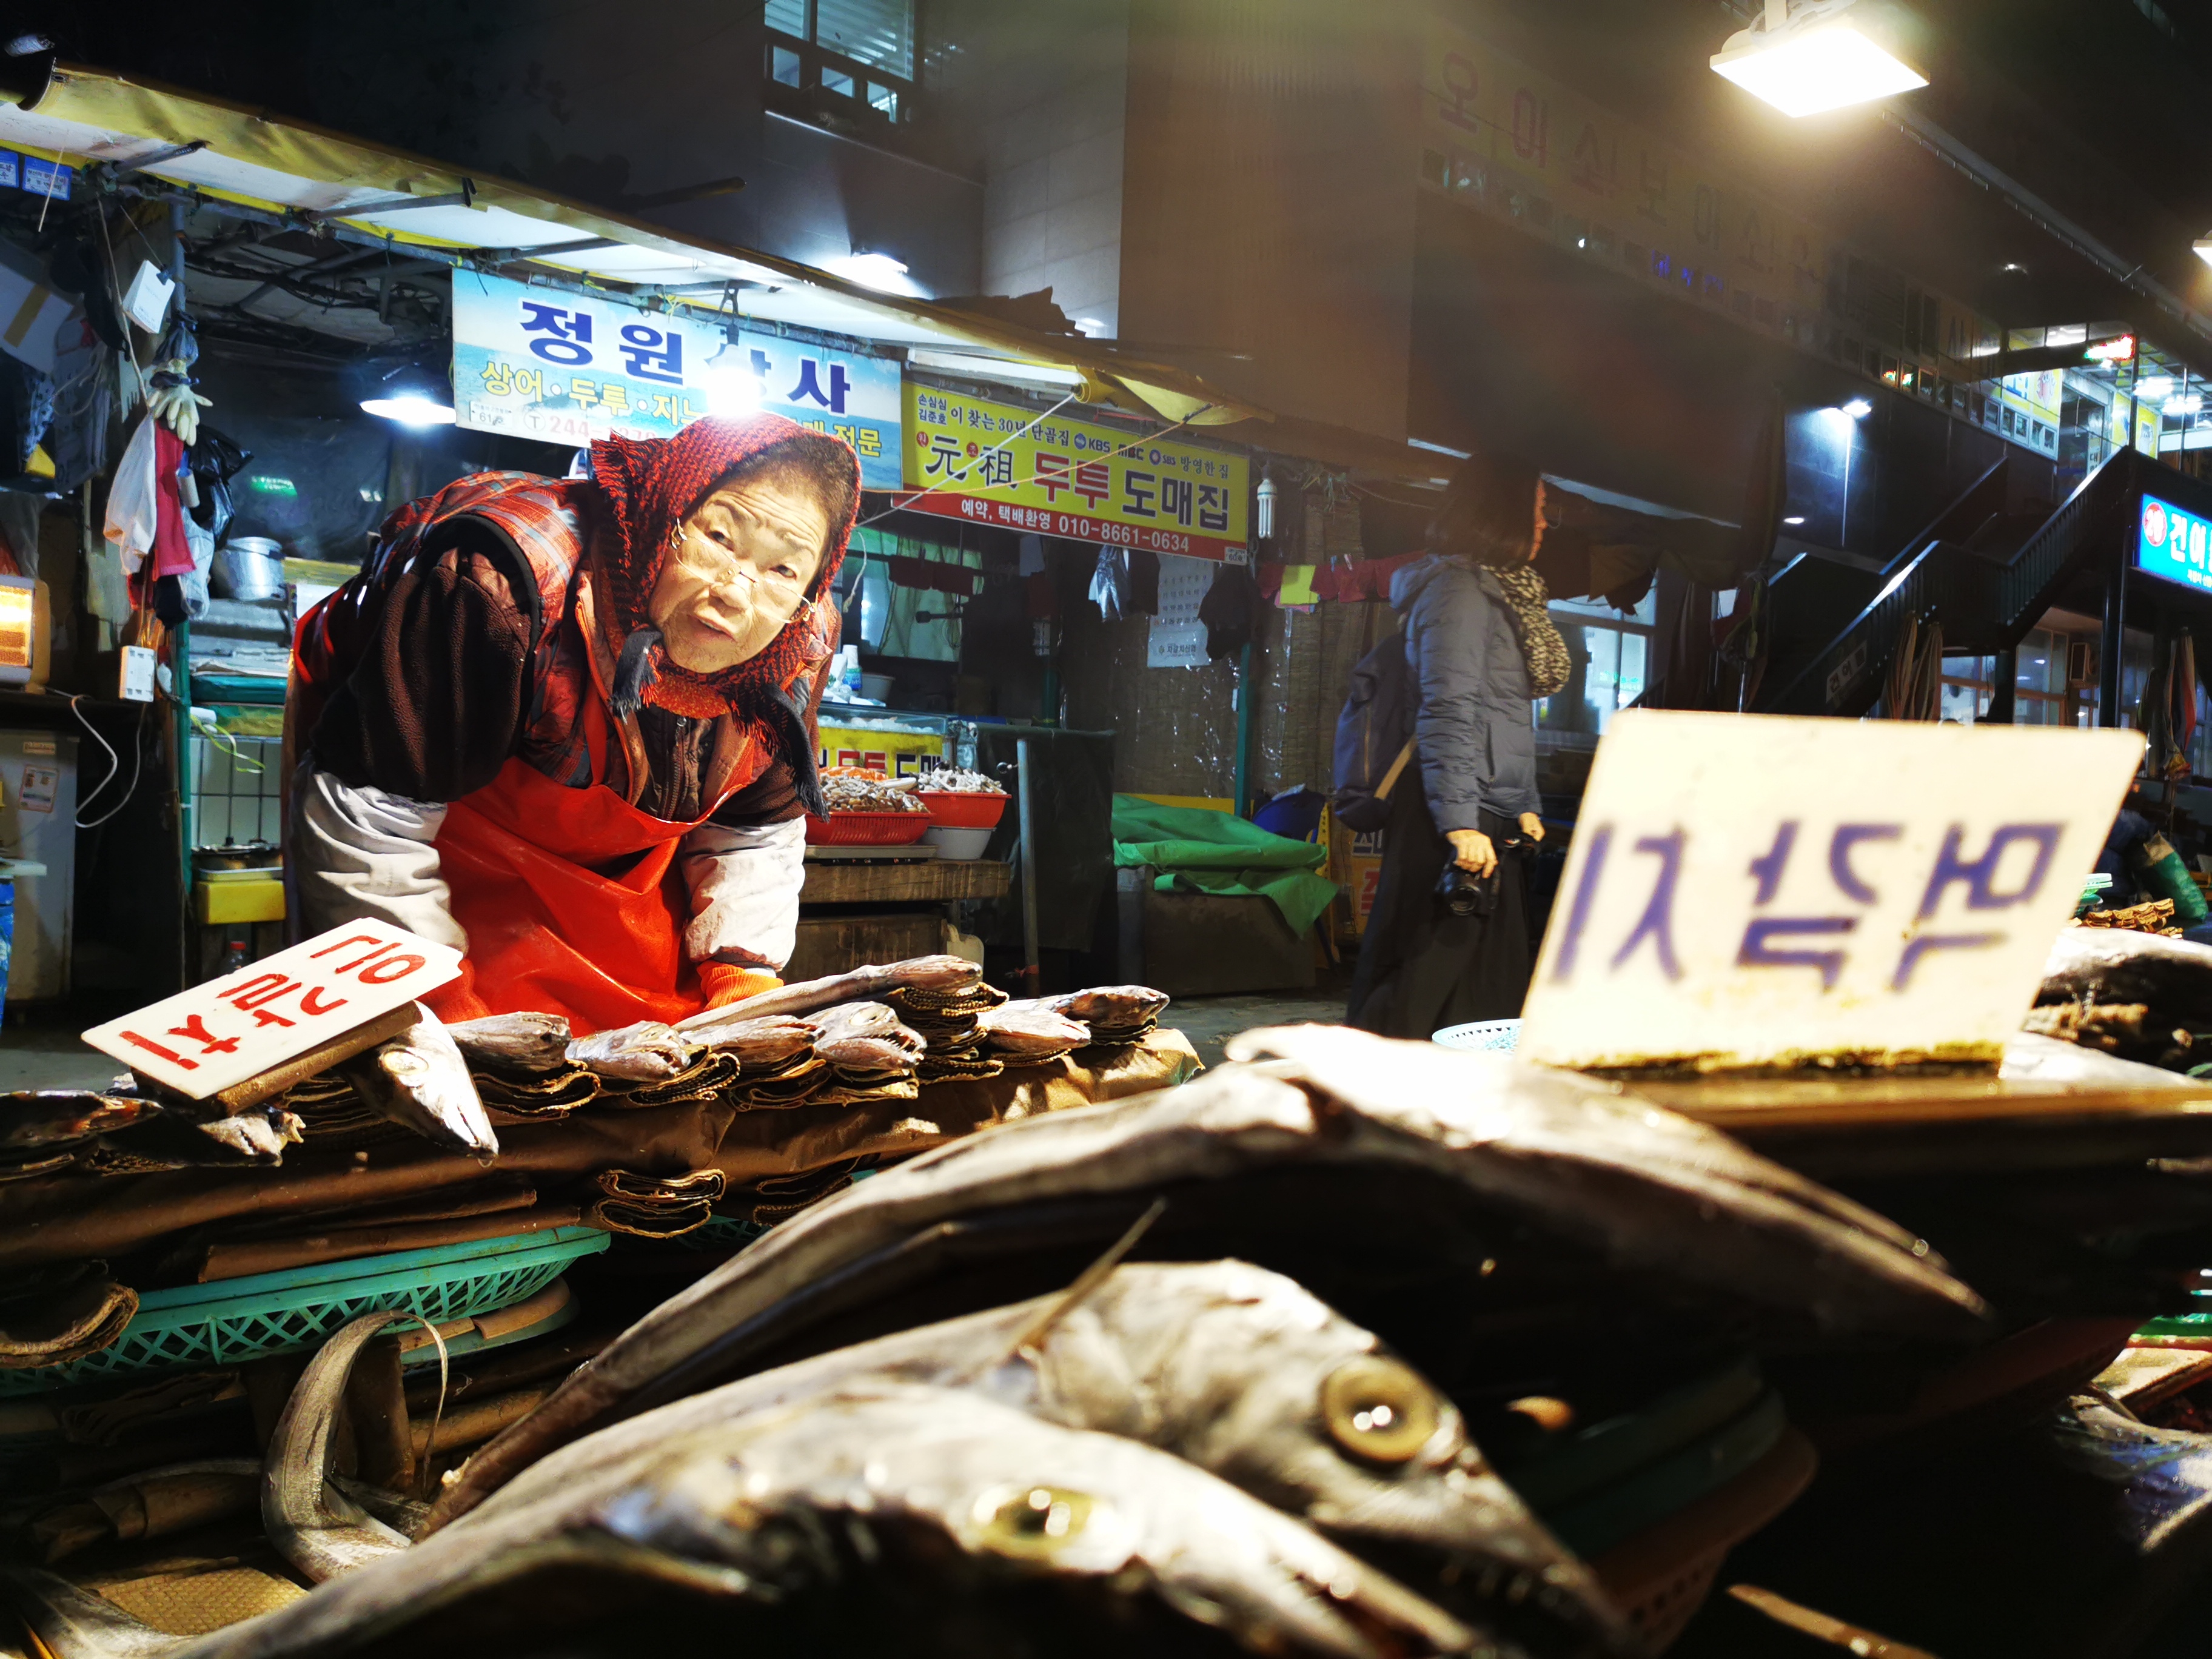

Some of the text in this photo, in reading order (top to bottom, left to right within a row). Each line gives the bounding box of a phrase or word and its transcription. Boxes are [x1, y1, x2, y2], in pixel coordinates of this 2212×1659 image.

[917, 392, 947, 411] 손심심
[918, 407, 947, 425] 김준호
[951, 406, 1228, 480] 이 찾는 30년 단골집 KBS MBC SBS 방영한 집
[1033, 451, 1110, 510] 두투
[1122, 469, 1229, 532] 도매집
[961, 498, 1190, 552] 예약, 택배환영 010-8661-0634
[2170, 512, 2212, 574] 건어
[119, 934, 426, 1070] 은갈치
